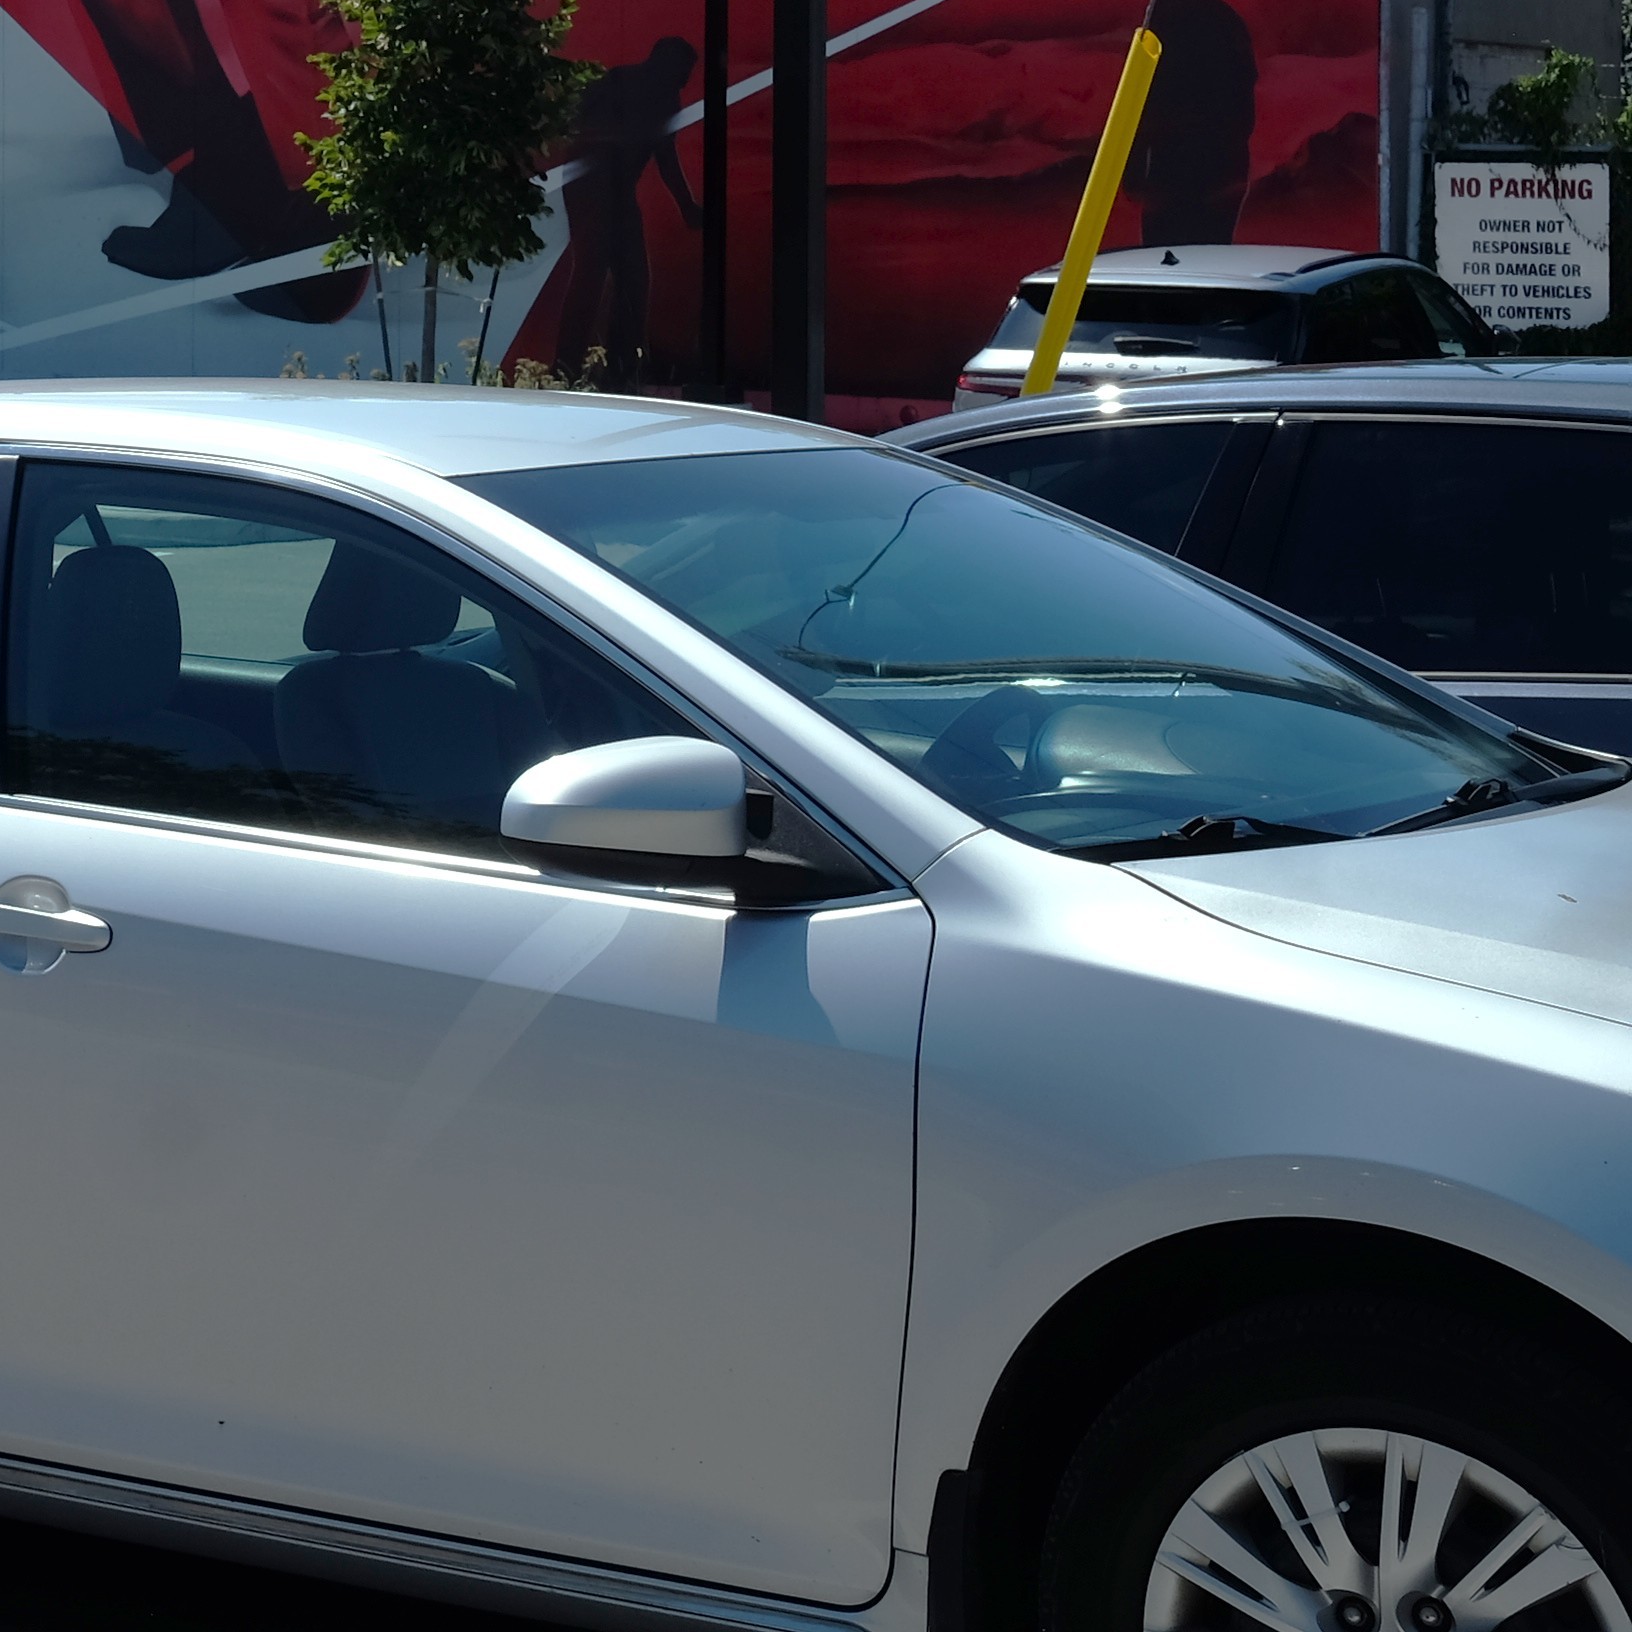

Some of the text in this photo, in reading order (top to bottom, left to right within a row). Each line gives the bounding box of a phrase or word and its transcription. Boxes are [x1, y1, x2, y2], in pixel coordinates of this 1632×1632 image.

[1450, 177, 1593, 200] NO PARKING
[1479, 219, 1564, 233] OWNER NOT
[1472, 241, 1571, 255] RESPONSIBLE
[1463, 262, 1581, 277] FOR DAMAGE OR
[1453, 283, 1592, 299] THEFT TO VEHICLES
[1497, 306, 1571, 320] CONTENTS
